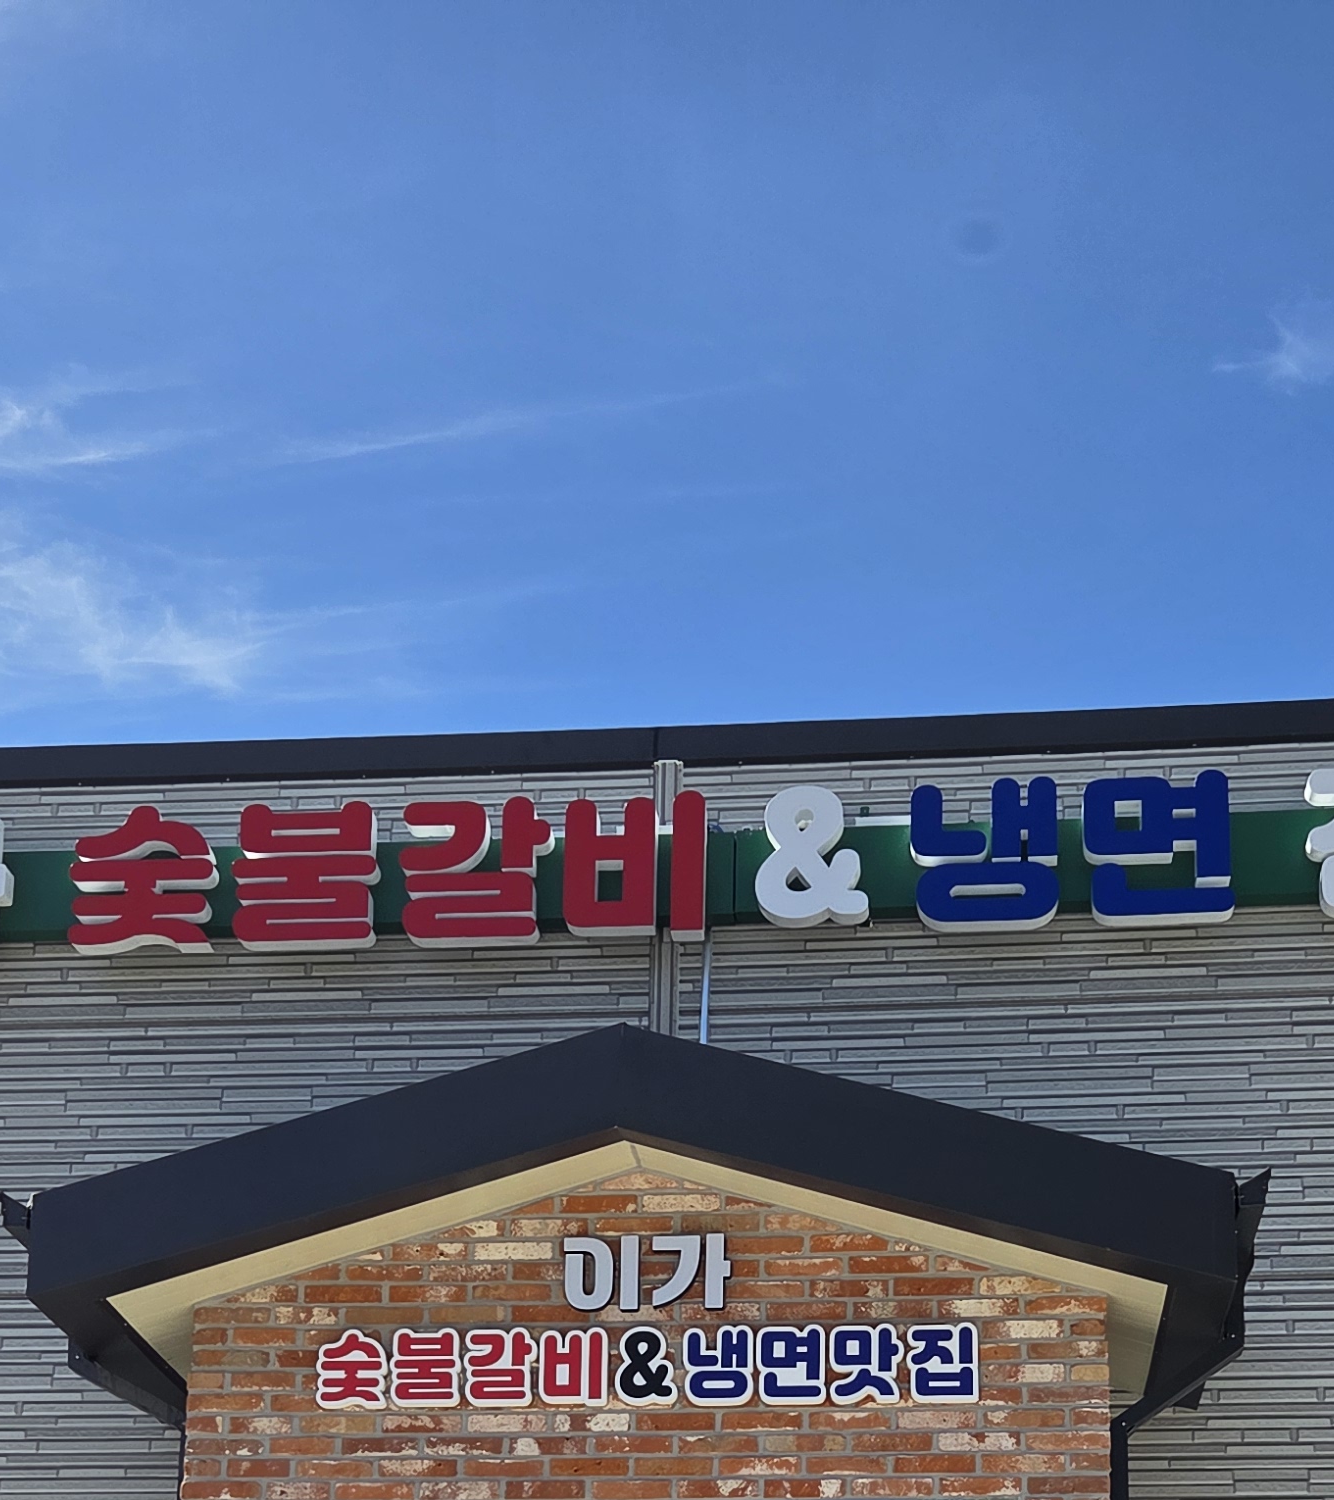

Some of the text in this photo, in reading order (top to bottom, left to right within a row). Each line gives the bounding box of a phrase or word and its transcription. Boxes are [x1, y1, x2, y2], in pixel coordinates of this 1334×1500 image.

[69, 790, 707, 953] 숯불갈비
[754, 785, 868, 928] &
[910, 769, 1234, 931] 냉면
[563, 1232, 731, 1311] 이가
